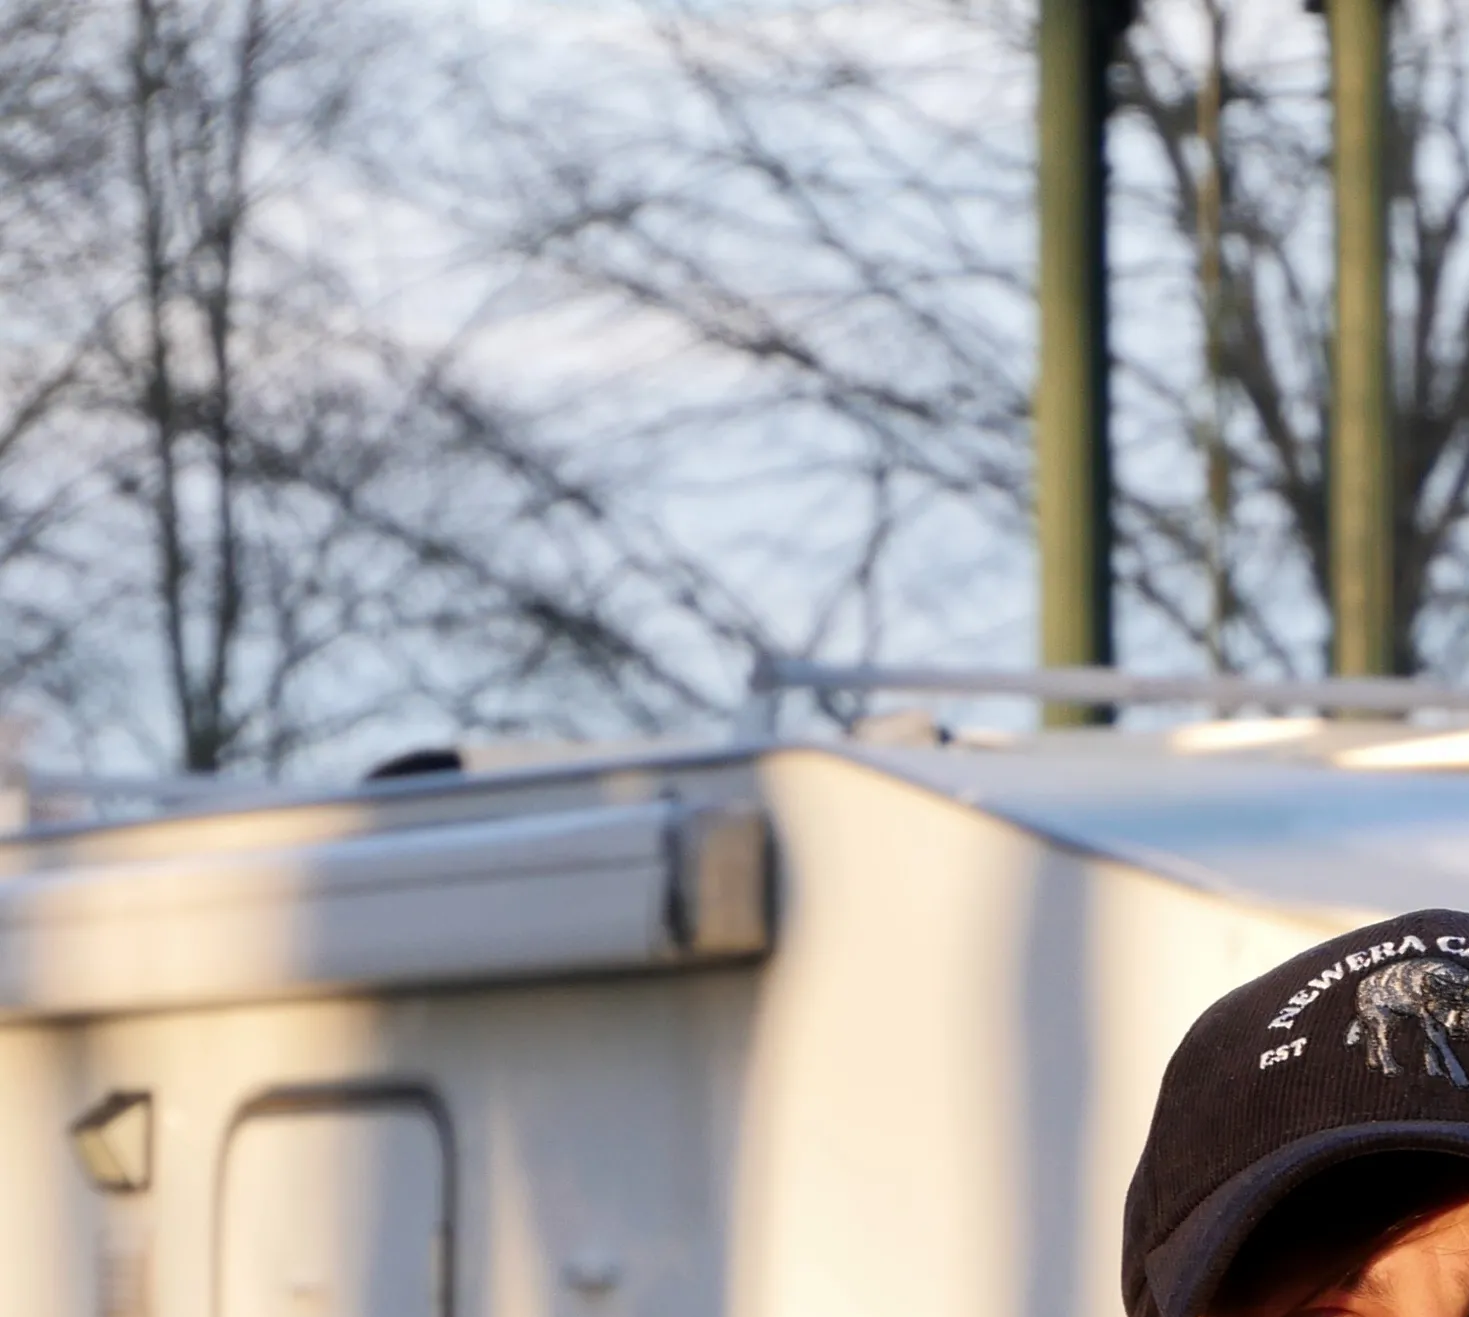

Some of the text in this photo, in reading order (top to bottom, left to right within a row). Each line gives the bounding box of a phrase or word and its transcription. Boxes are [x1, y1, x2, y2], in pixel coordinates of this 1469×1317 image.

[1267, 961, 1344, 1030] NEW
[1345, 935, 1427, 972] ERA
[1259, 1037, 1308, 1070] EST
